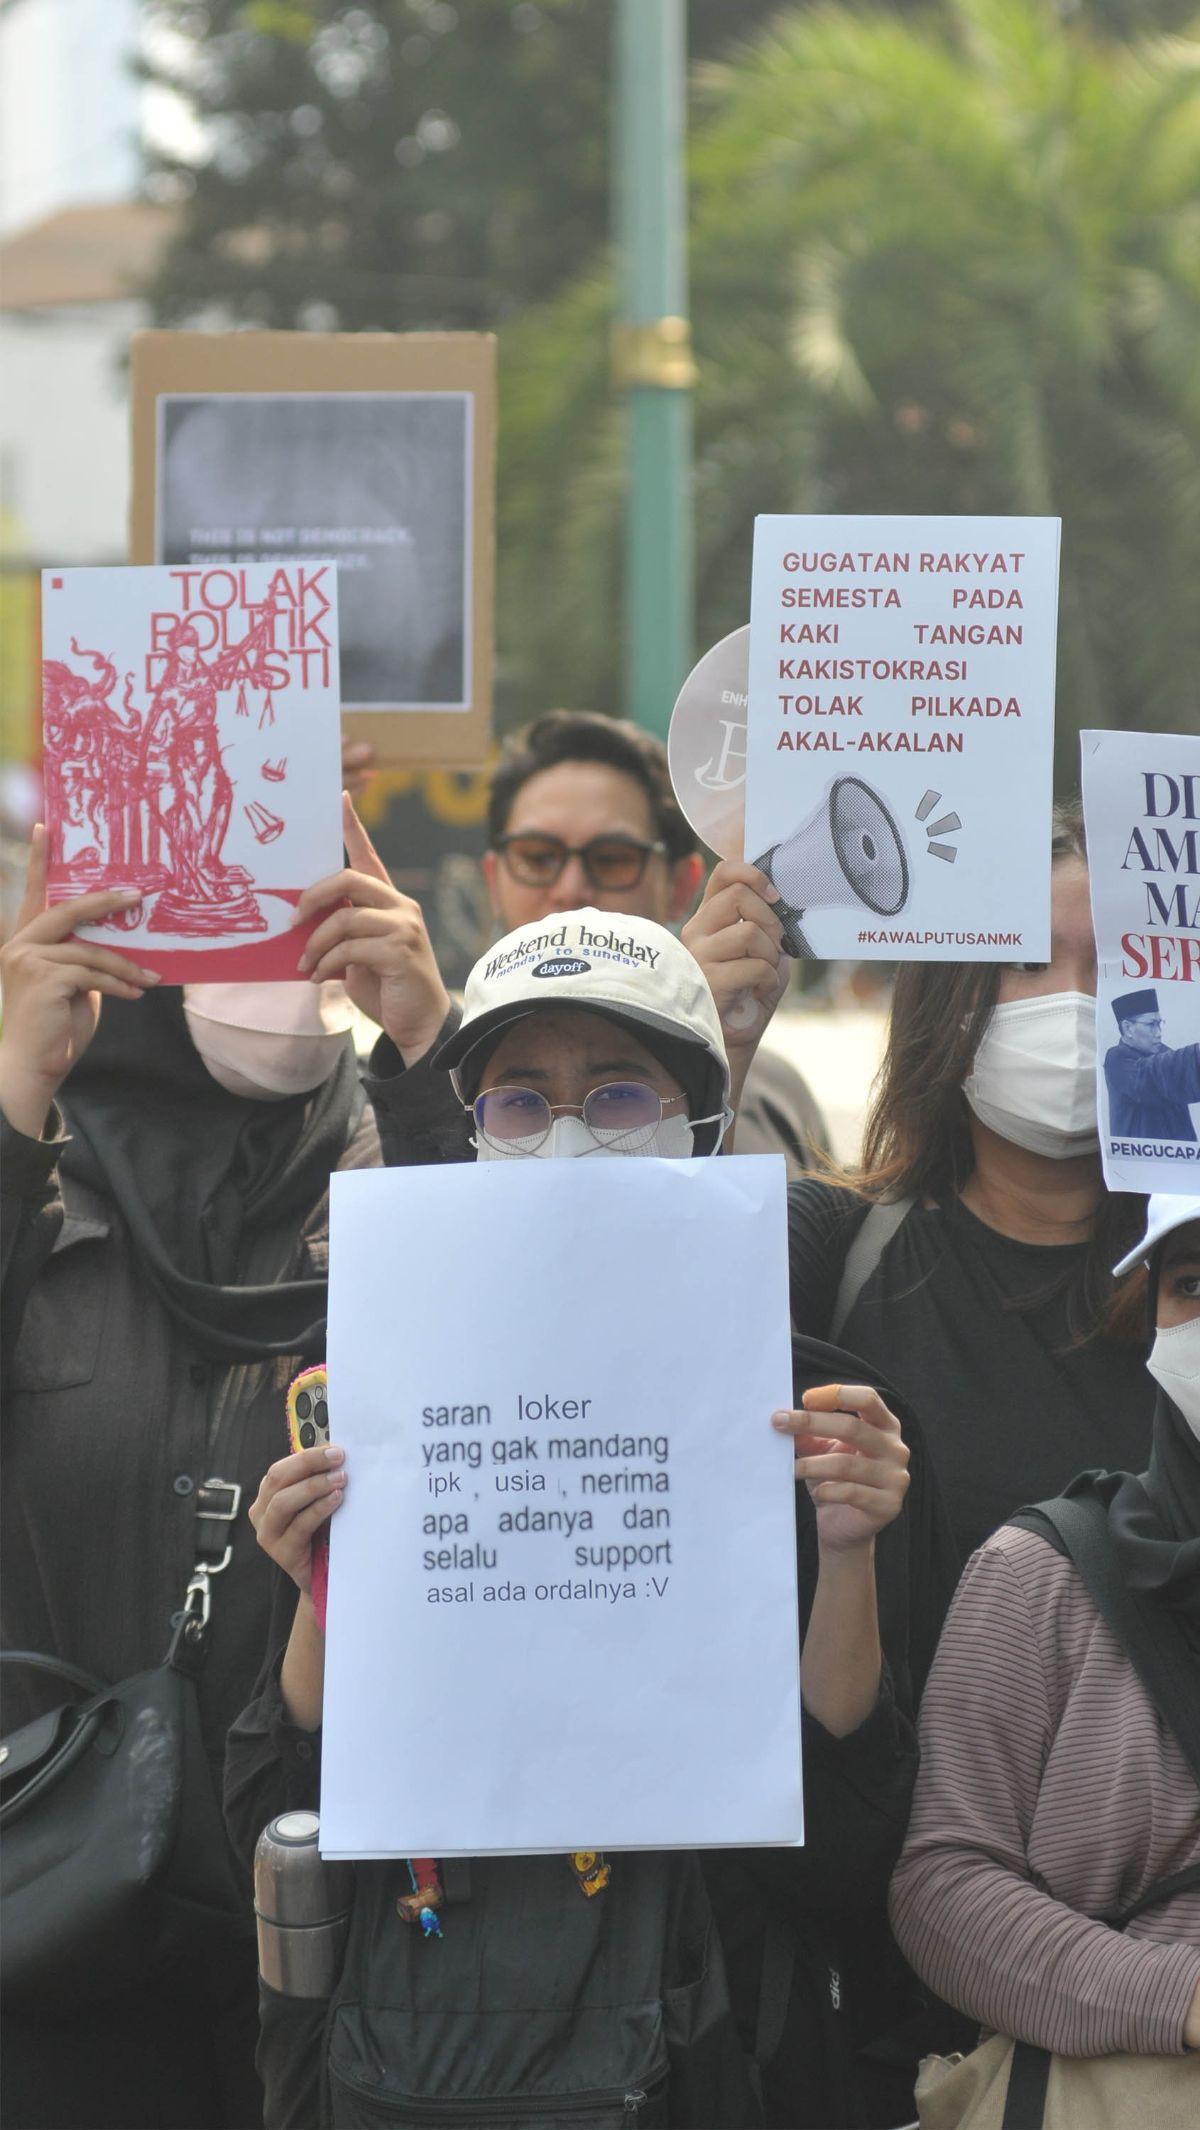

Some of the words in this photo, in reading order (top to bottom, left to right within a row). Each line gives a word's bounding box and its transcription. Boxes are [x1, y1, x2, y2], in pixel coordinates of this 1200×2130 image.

[782, 552, 910, 573] GUGATAN
[918, 552, 1025, 573] RAKYAT
[169, 566, 330, 611] TOLAK
[781, 588, 902, 608] SEMESTA
[952, 589, 1024, 609] PADA
[151, 606, 332, 652] POLITIK
[780, 624, 839, 643] KAKI
[913, 624, 1023, 645] TANGAN
[779, 659, 967, 680] KAKISTOKRASI
[778, 695, 864, 716] TOLAK
[911, 696, 1022, 717] PILKADA
[776, 731, 964, 752] AKAL-AKALAN
[857, 930, 1022, 945] #KAWALPUTUSANMK
[484, 926, 567, 980] Weekend
[497, 951, 544, 979] monday
[556, 947, 572, 956] to
[583, 948, 640, 968] sunday
[540, 962, 585, 976] dayoff
[422, 1404, 491, 1428] saran
[518, 1394, 592, 1421] loker
[422, 1440, 482, 1468] yang
[491, 1436, 538, 1466] gak
[547, 1433, 670, 1463] mandang
[428, 1472, 461, 1498] ipk
[495, 1469, 546, 1492] usia
[582, 1467, 670, 1494] nerima
[422, 1512, 469, 1541] apa
[498, 1505, 594, 1538] adanya
[622, 1502, 671, 1530] dan
[423, 1543, 497, 1571] selalu
[574, 1539, 672, 1572] support
[427, 1582, 474, 1603] asal
[482, 1581, 526, 1601] ada
[534, 1578, 637, 1604] ordalnya
[644, 1577, 669, 1598] :V
